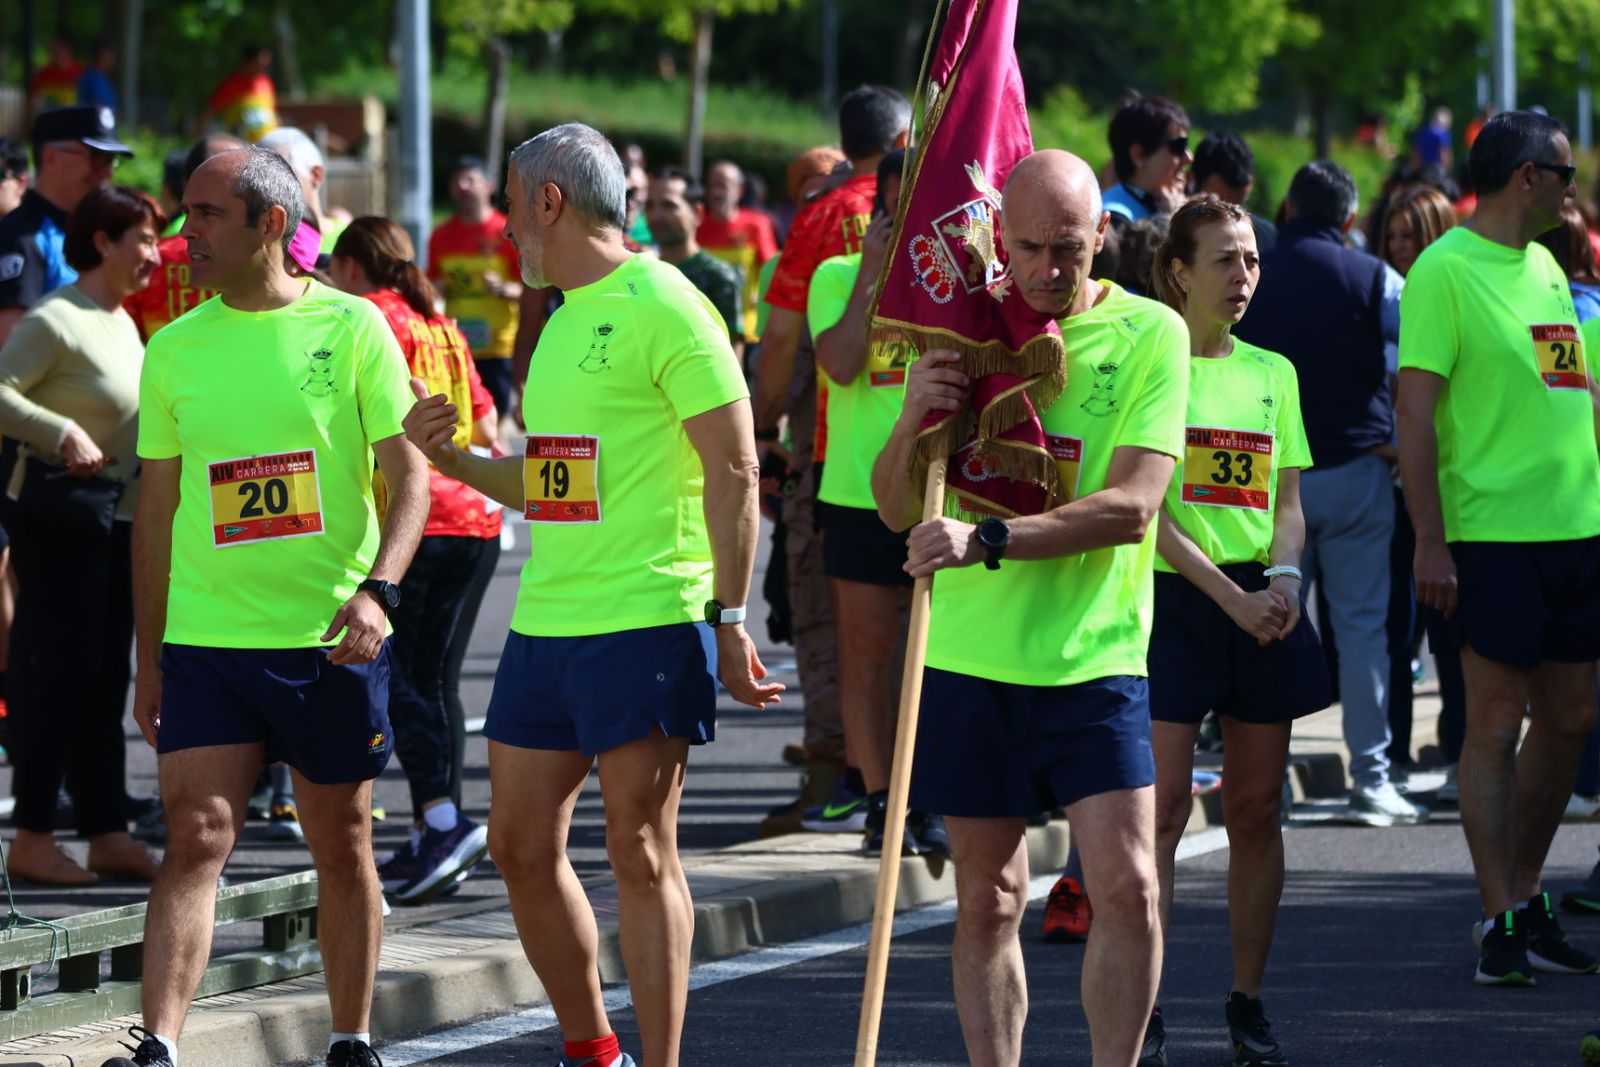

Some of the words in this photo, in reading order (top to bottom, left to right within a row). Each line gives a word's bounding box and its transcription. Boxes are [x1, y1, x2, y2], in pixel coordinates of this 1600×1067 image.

[1550, 343, 1577, 371] 24
[540, 446, 569, 457] CARRERA
[1213, 438, 1255, 450] CARRERA
[236, 463, 286, 479] CARRERA
[540, 460, 570, 499] 19
[1211, 450, 1253, 487] 33
[238, 478, 288, 519] 20
